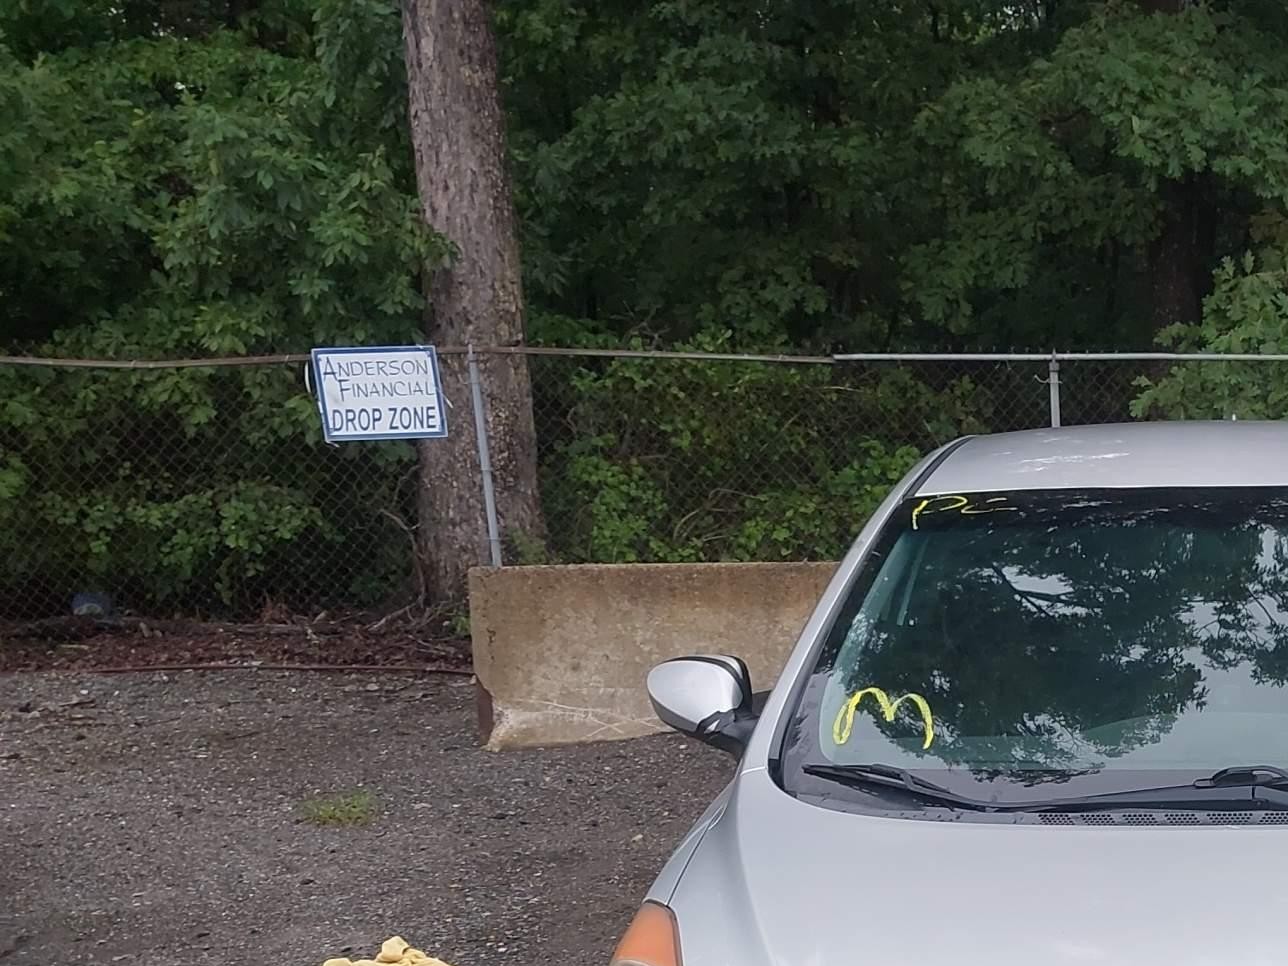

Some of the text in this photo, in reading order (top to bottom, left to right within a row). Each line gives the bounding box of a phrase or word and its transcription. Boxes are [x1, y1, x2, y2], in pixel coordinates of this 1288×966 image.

[323, 356, 428, 380] ANDERSON
[337, 379, 435, 402] FINANCIAL
[332, 406, 437, 432] DROP ZONE
